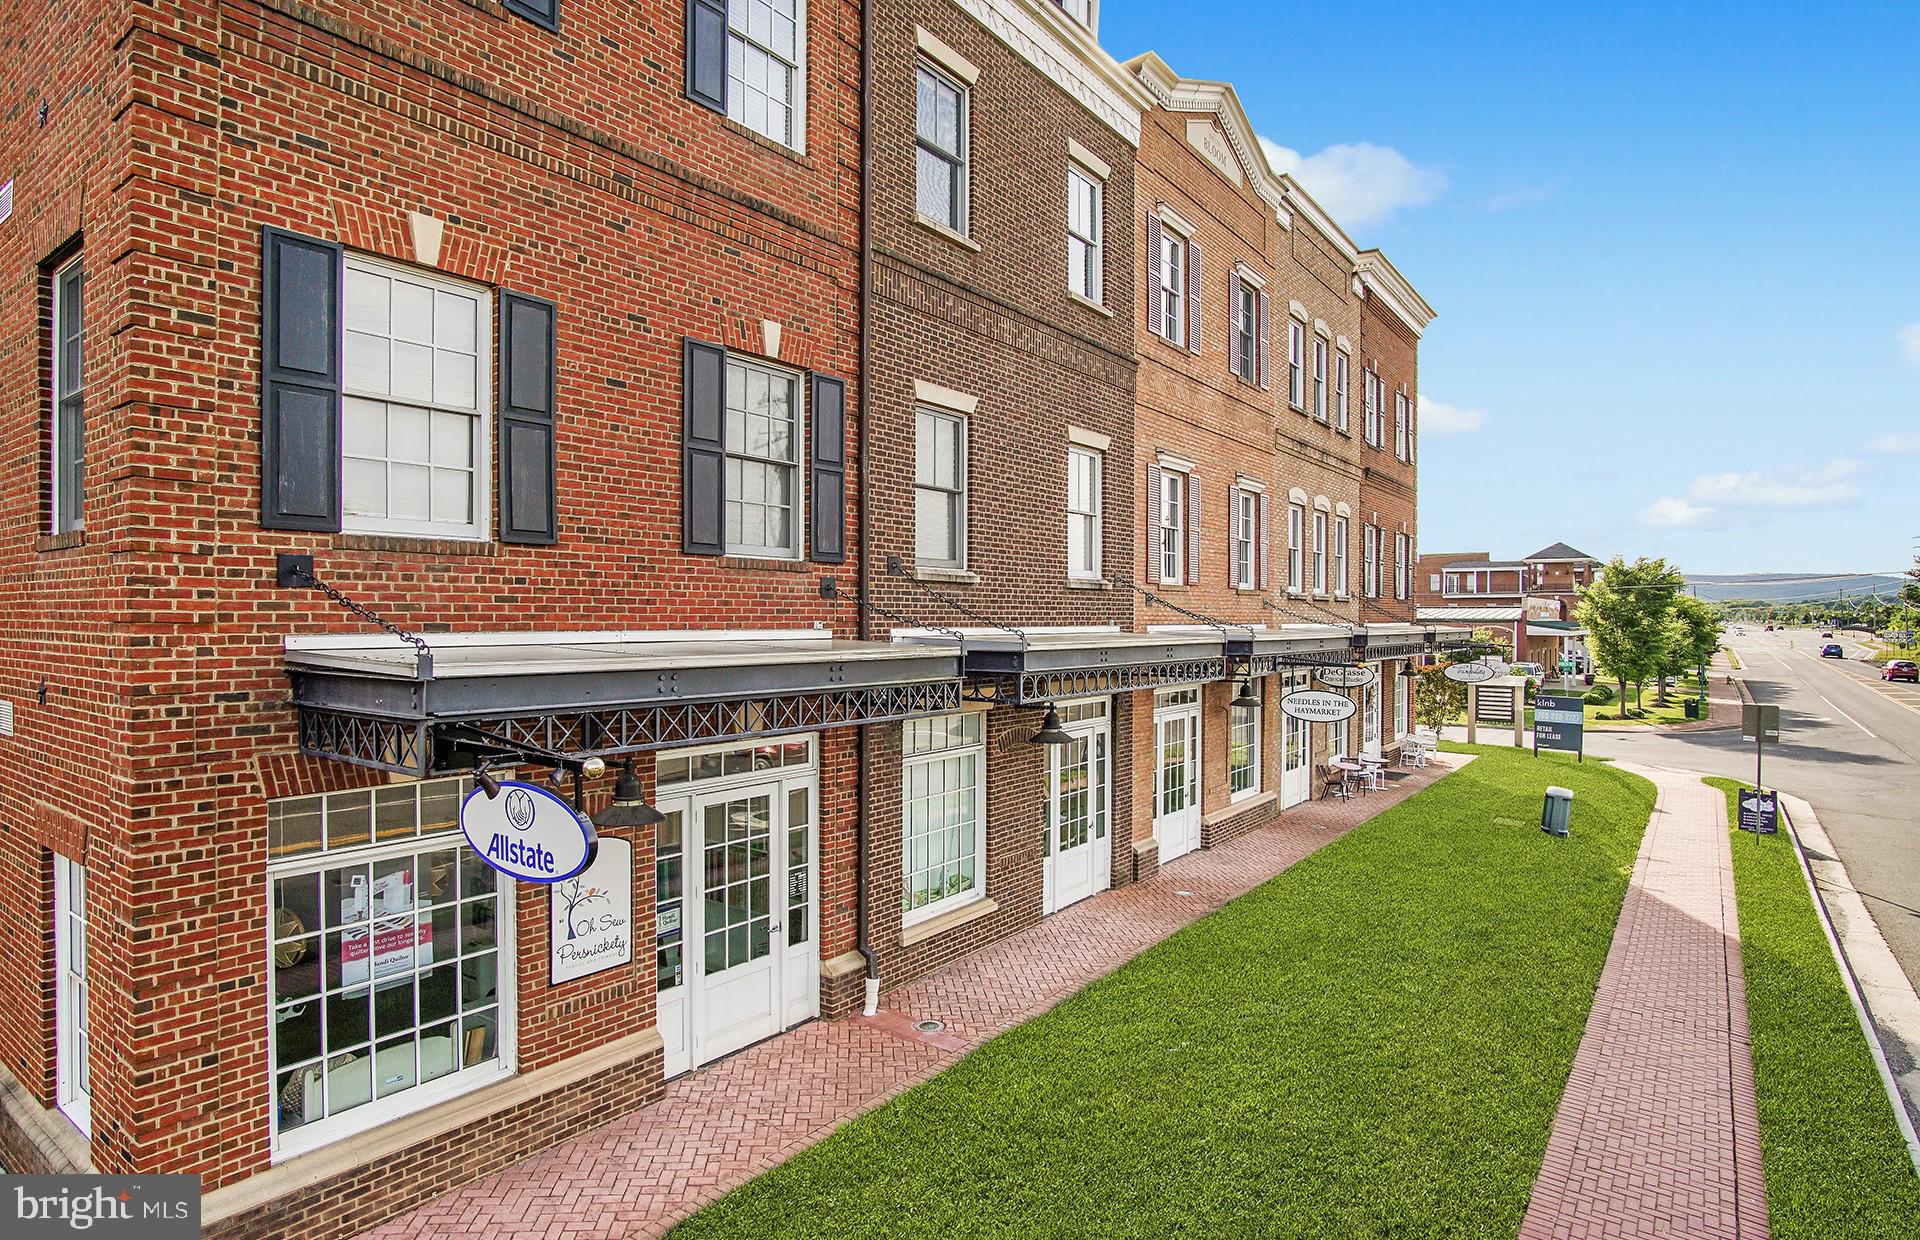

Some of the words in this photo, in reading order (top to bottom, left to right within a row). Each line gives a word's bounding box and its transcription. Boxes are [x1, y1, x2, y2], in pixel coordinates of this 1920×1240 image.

[1203, 137, 1227, 168] BLOOM
[1323, 667, 1366, 677] DeGasse
[1287, 697, 1321, 706] NEEDLES
[1333, 700, 1349, 708] THE
[1536, 699, 1556, 708] klnb
[1294, 707, 1341, 716] HAYMARKET
[1536, 725, 1553, 733] RETAIL
[486, 832, 555, 874] Allstate
[576, 918, 597, 937] Oh
[599, 914, 627, 932] Sew
[348, 943, 362, 951] Take
[556, 935, 628, 965] Persnickety
[374, 958, 389, 967] andi
[389, 954, 410, 963] Quilter
